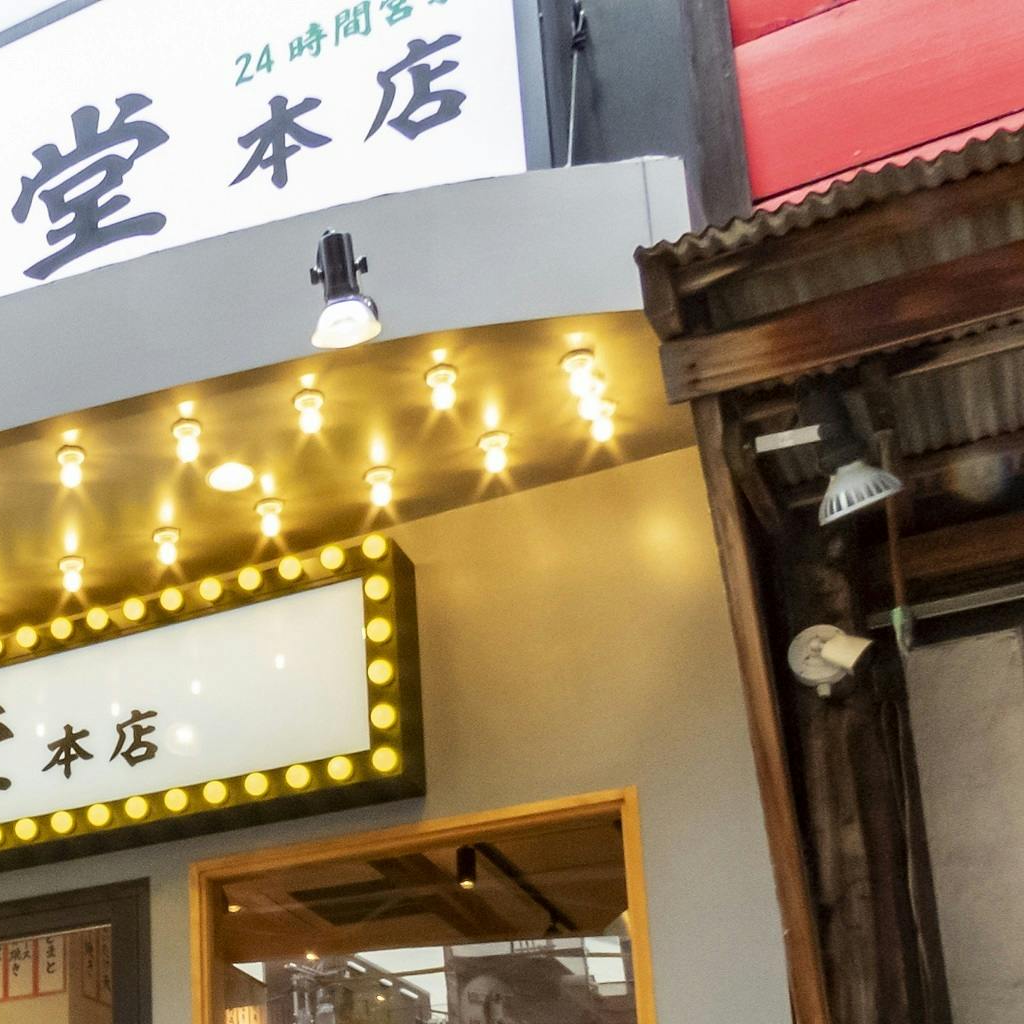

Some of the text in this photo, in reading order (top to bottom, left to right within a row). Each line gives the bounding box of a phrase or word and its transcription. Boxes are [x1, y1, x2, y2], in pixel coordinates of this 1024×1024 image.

[235, 0, 448, 86] 24時間営
[228, 34, 467, 189] 本店
[42, 709, 158, 780] 本店
